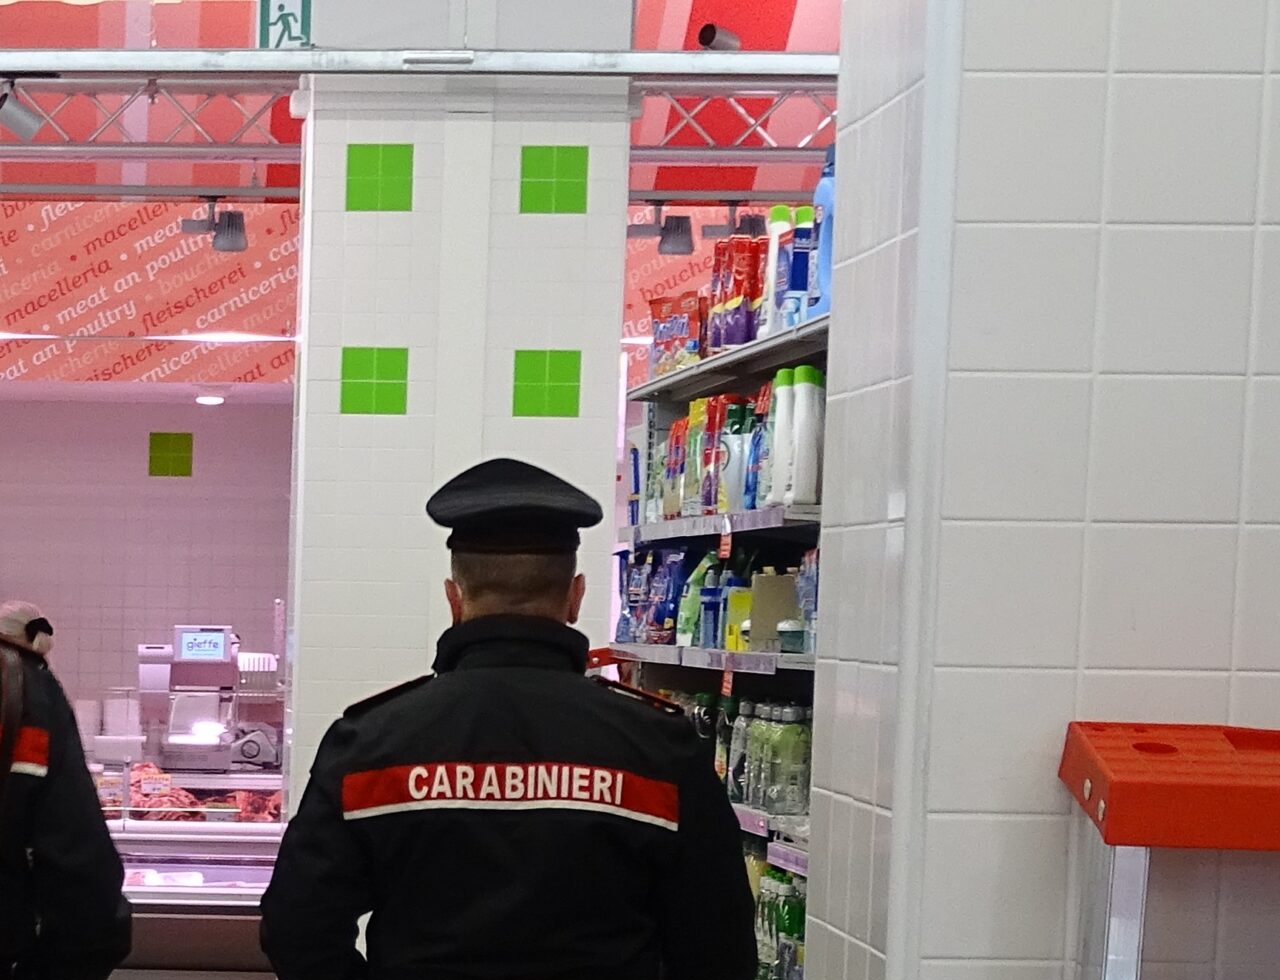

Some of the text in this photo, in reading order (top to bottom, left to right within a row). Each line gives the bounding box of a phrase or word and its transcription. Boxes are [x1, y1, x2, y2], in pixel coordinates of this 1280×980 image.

[4, 259, 113, 326] macelleria
[56, 285, 111, 325] meat
[114, 270, 143, 294] an
[141, 262, 247, 334] fleischerei
[195, 263, 299, 329] carniceria
[639, 255, 715, 300] bouche
[32, 342, 61, 366] an
[186, 637, 219, 651] gieffe
[408, 764, 624, 805] CARABINIERI
